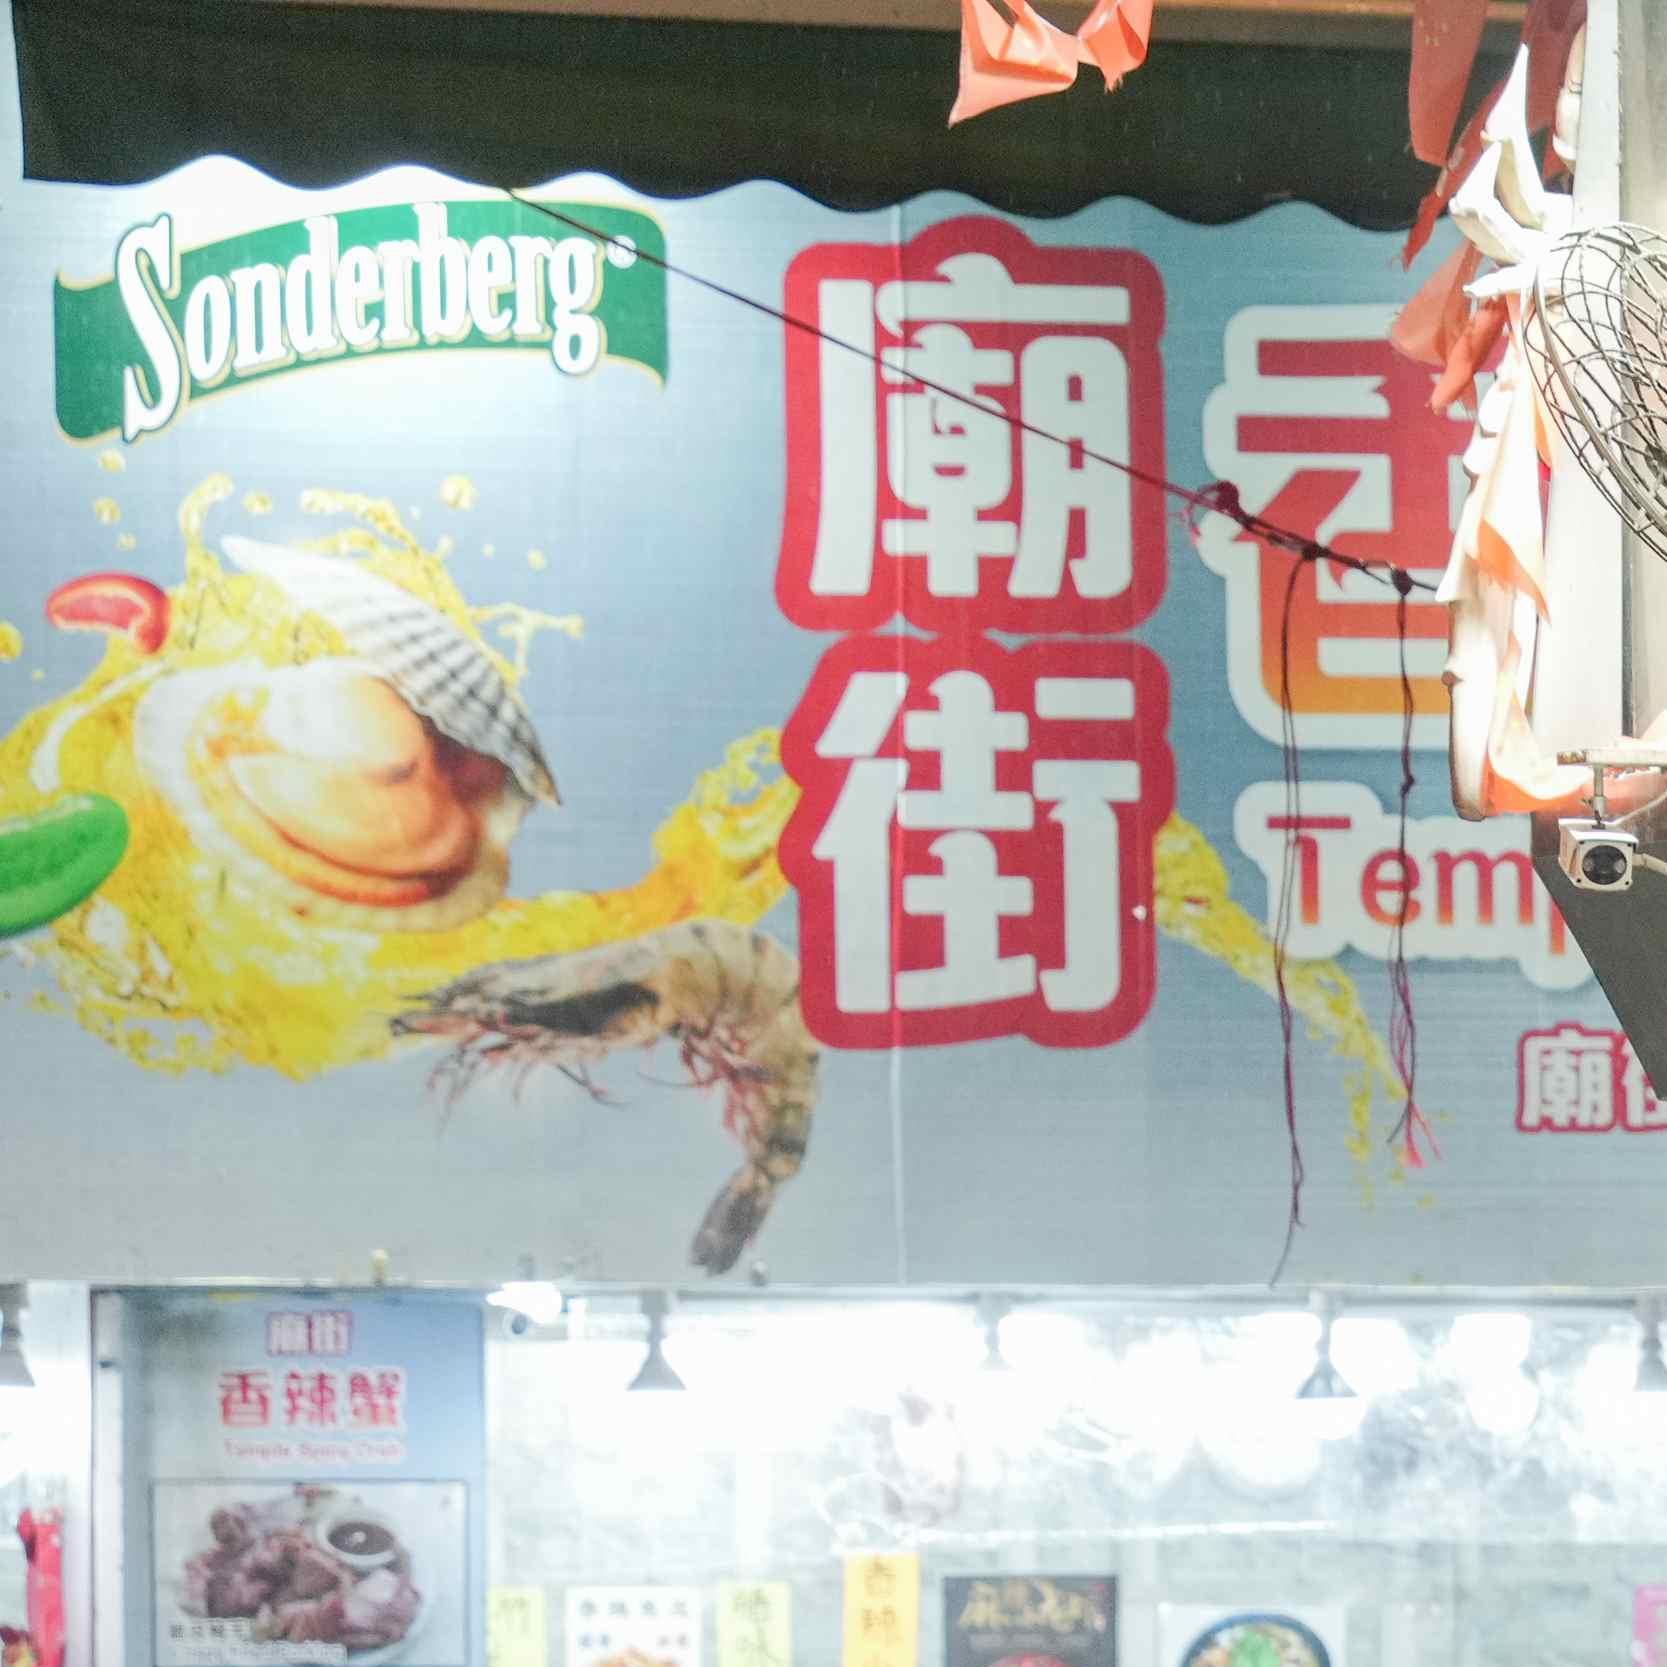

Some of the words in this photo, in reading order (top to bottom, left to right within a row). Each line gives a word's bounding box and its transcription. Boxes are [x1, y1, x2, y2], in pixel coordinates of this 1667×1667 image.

[805, 245, 1148, 1020] 廟街
[219, 1370, 401, 1427] 香辣蟹
